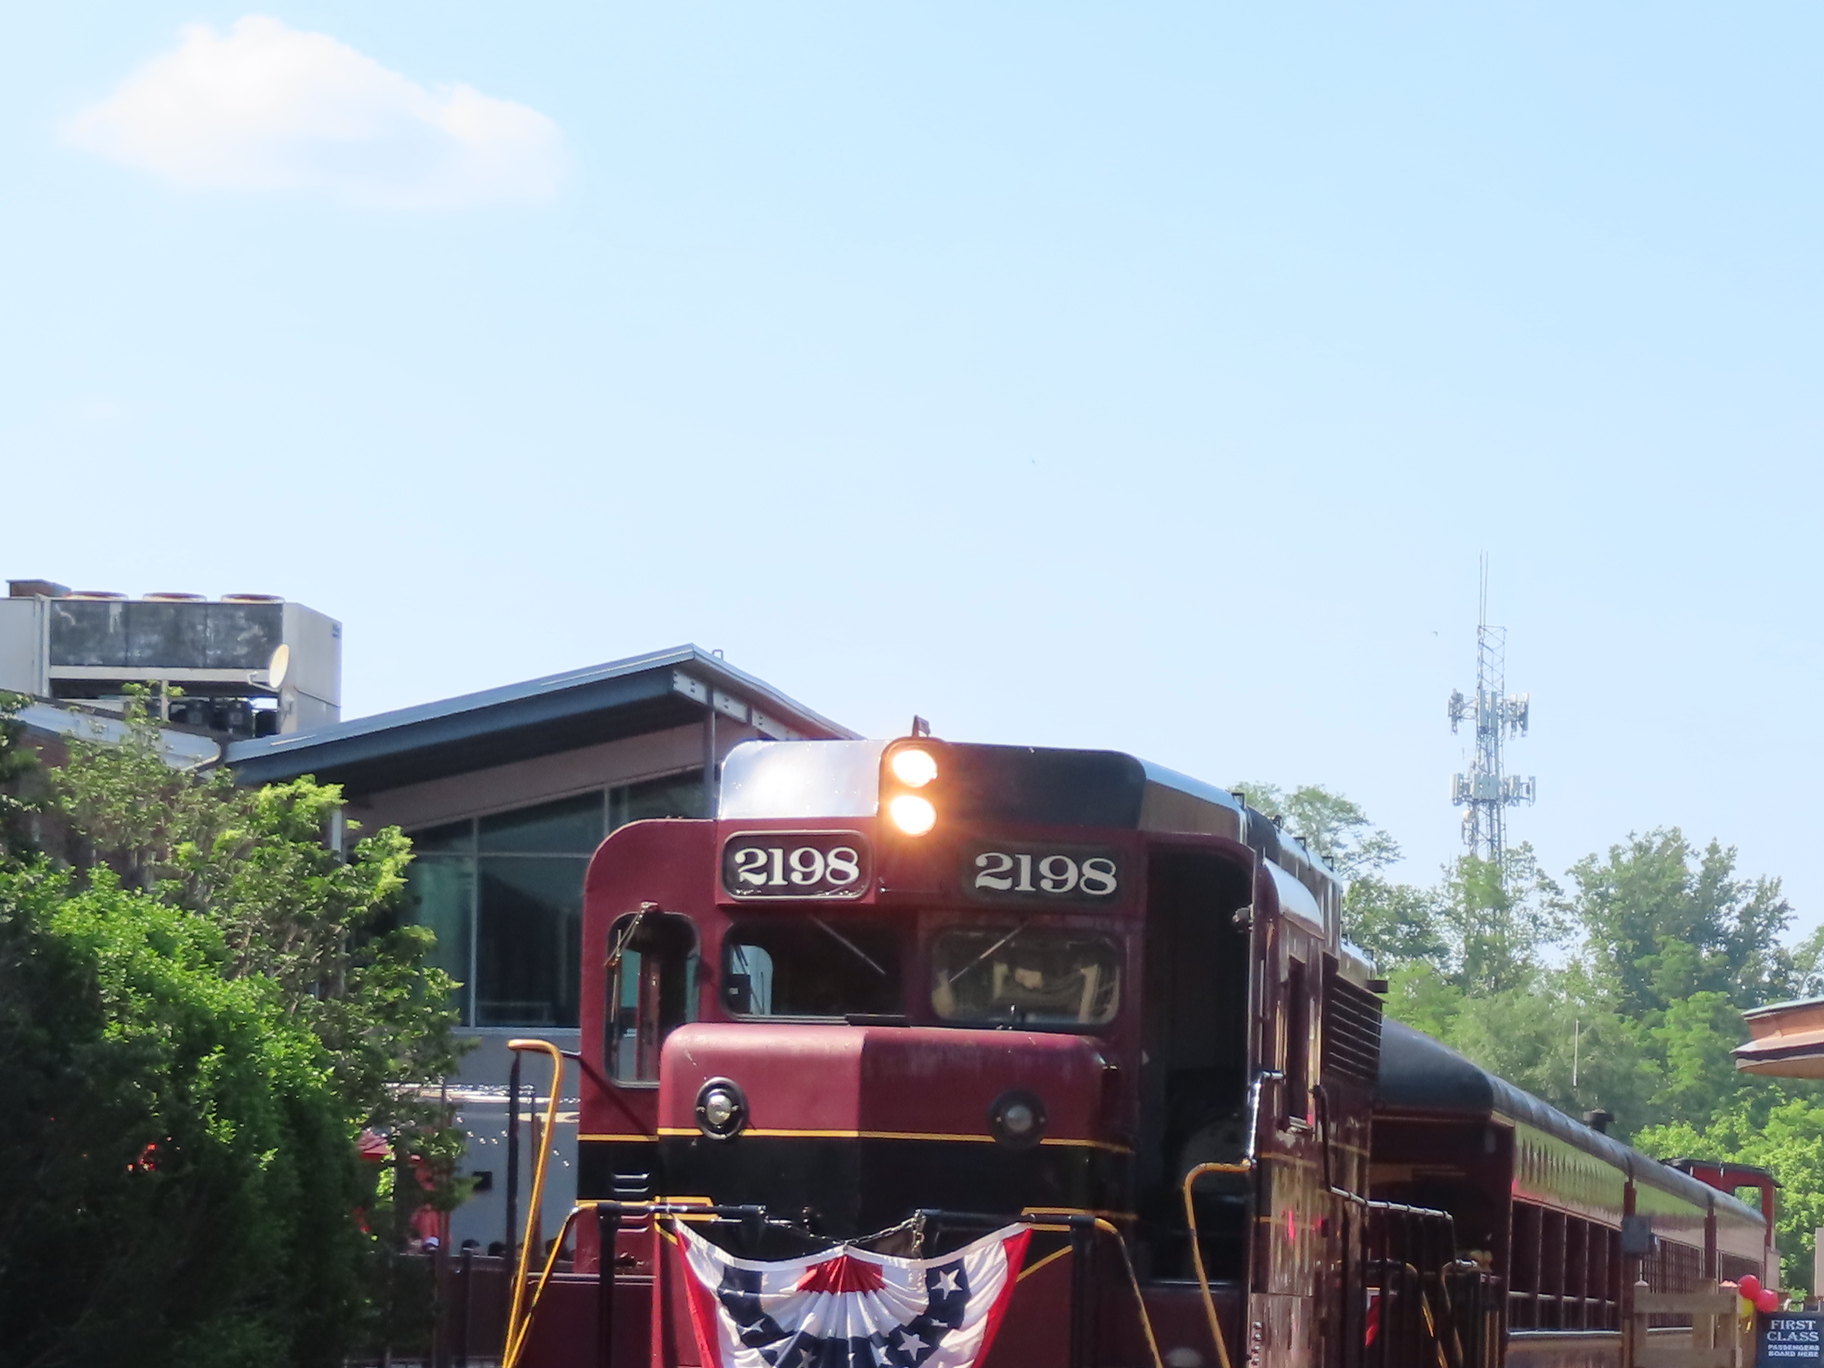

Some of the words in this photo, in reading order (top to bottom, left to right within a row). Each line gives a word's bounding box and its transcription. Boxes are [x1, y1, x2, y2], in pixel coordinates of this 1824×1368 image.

[734, 847, 860, 886] 2198
[974, 852, 1118, 895] 2198
[1766, 1331, 1820, 1342] CLASS
[1770, 1320, 1816, 1330] FIRST
